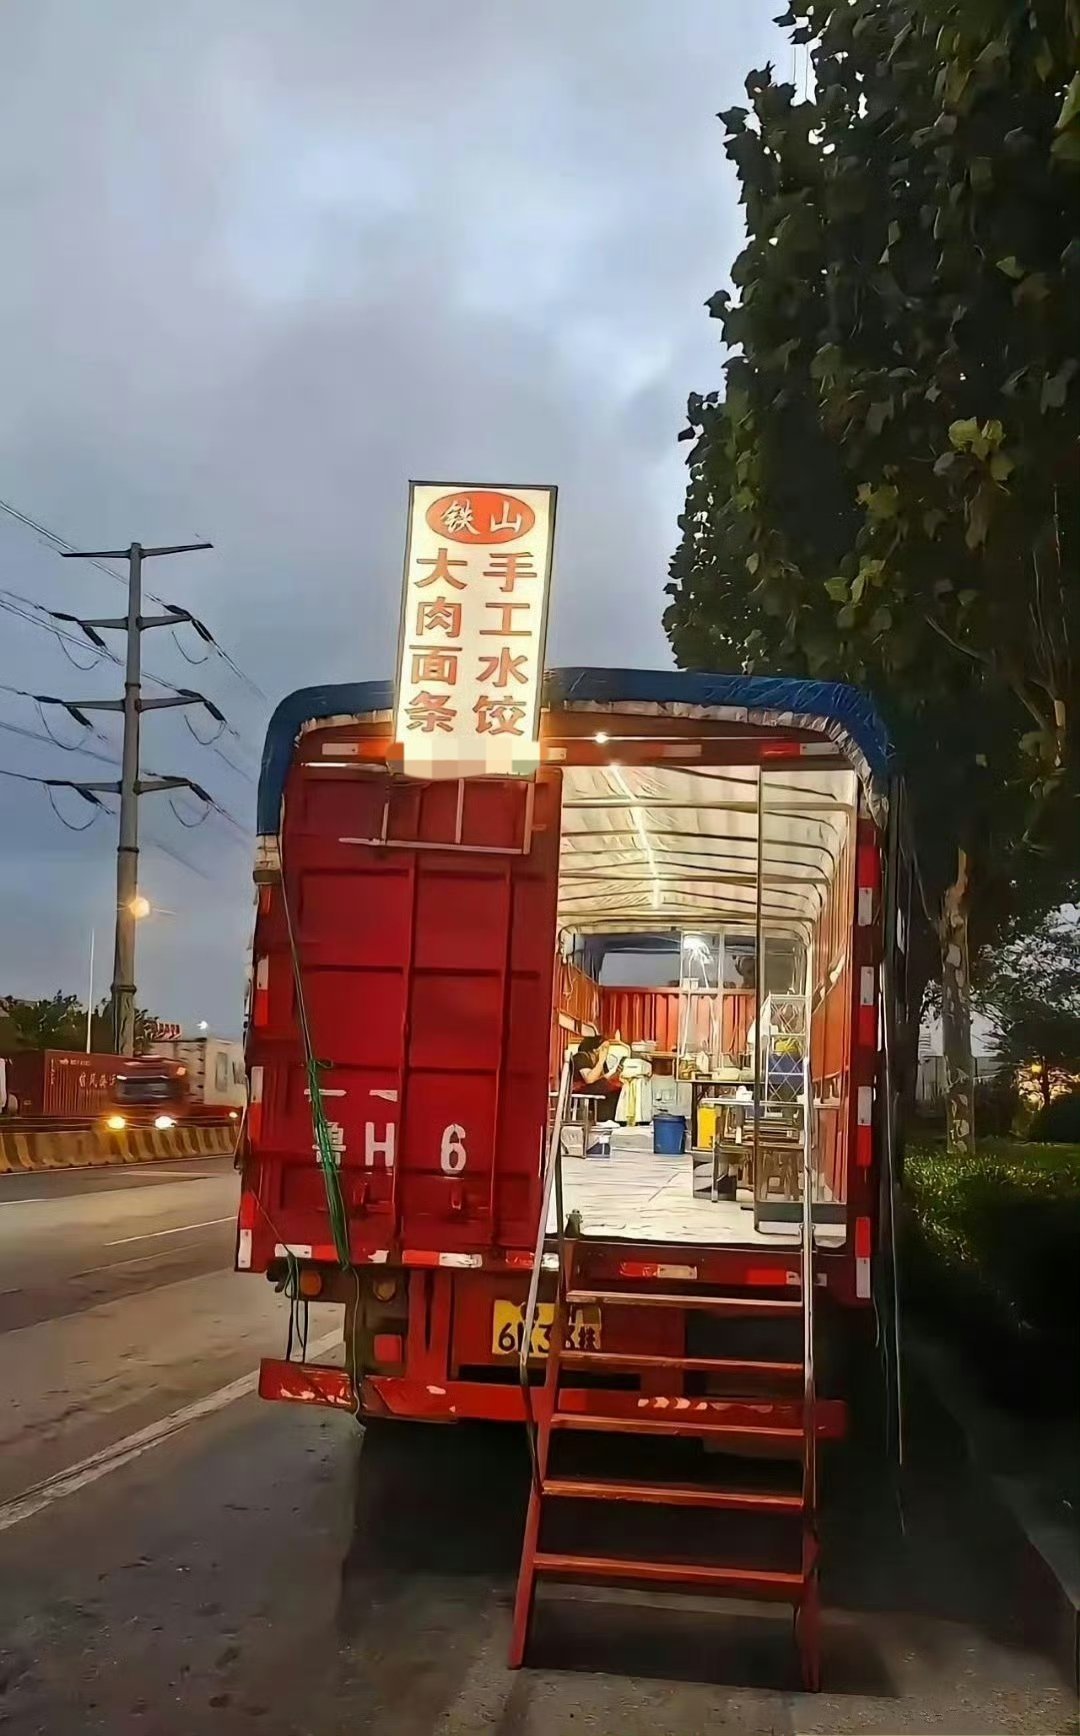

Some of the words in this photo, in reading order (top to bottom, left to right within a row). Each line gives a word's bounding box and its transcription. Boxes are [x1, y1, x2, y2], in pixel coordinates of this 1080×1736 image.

[404, 547, 468, 734] 大肉面条
[472, 551, 538, 737] 手工水饺
